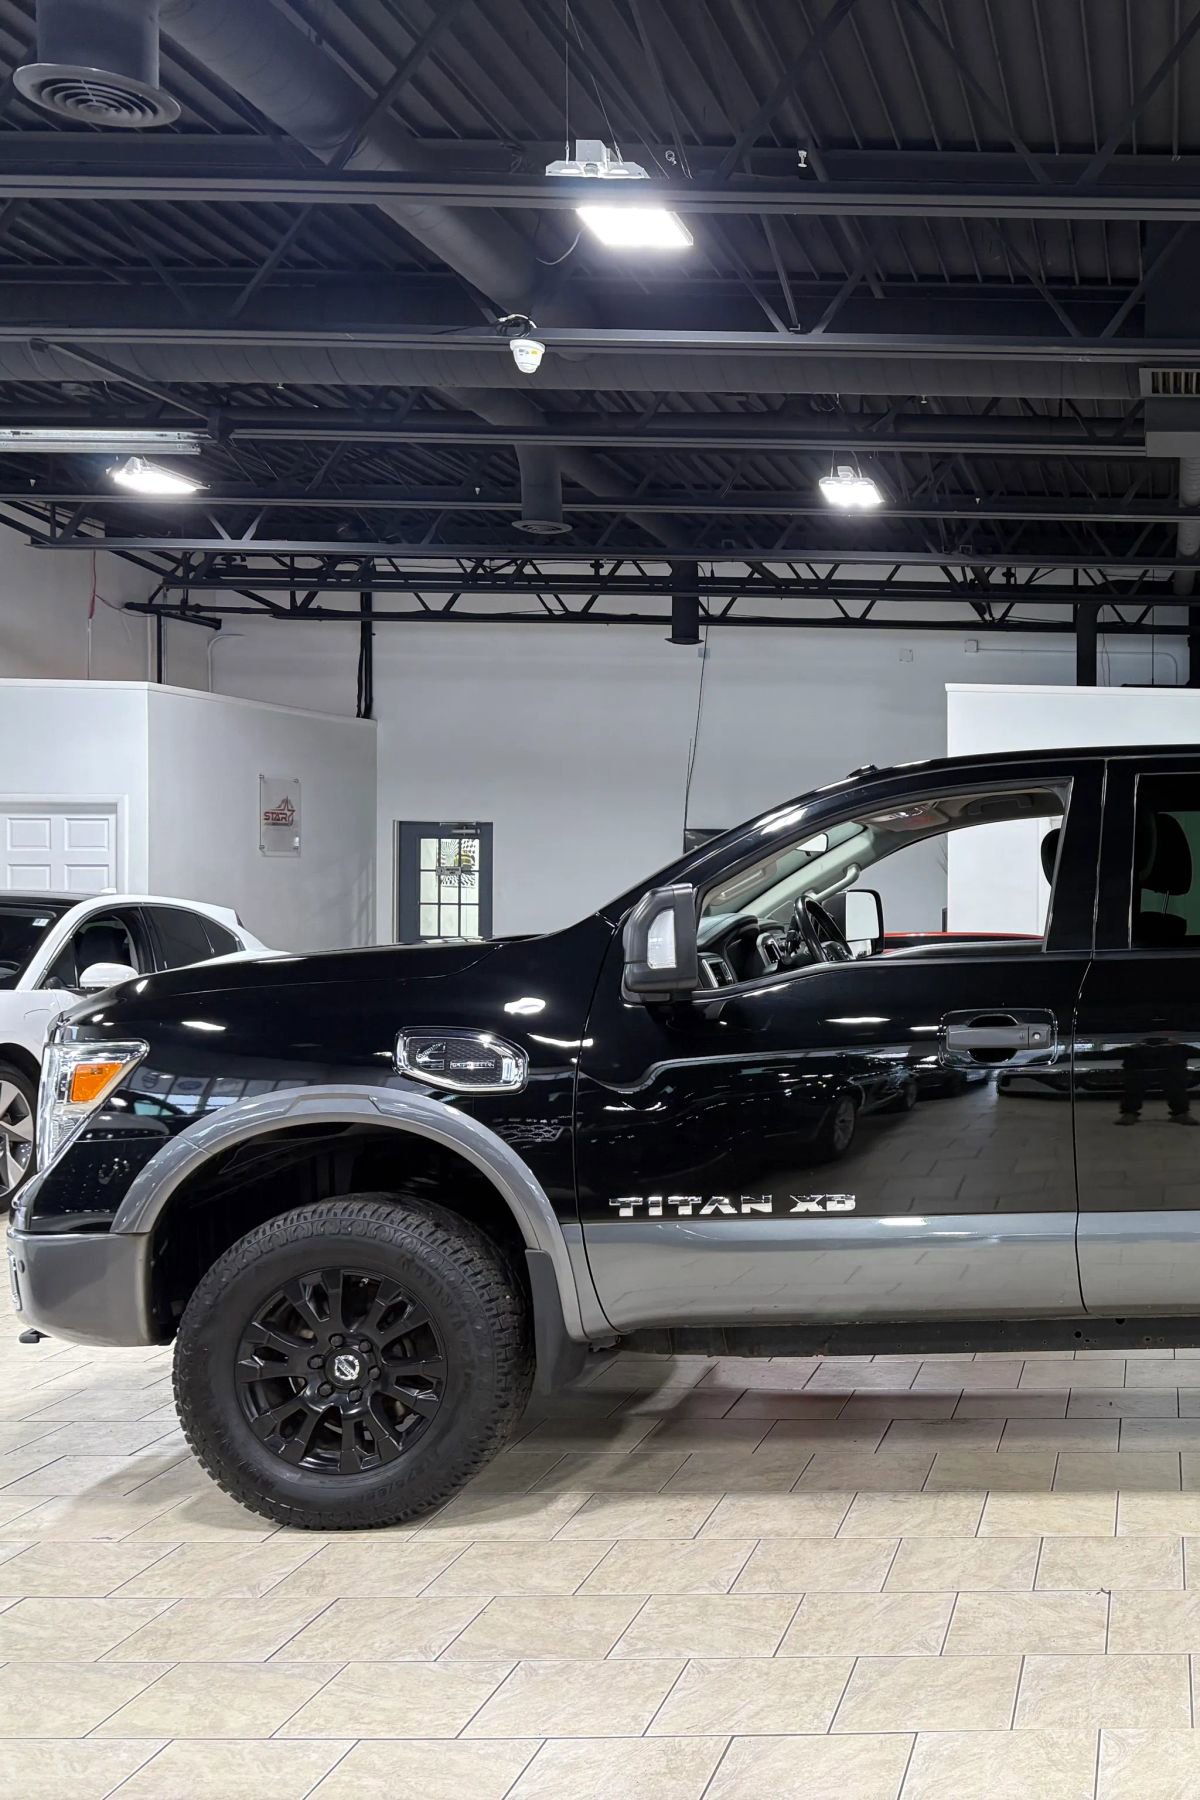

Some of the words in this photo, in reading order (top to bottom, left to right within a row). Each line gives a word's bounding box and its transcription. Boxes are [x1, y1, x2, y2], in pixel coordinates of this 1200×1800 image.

[263, 811, 288, 822] STAR
[608, 1194, 773, 1217] TITAN
[789, 1193, 857, 1213] XD
